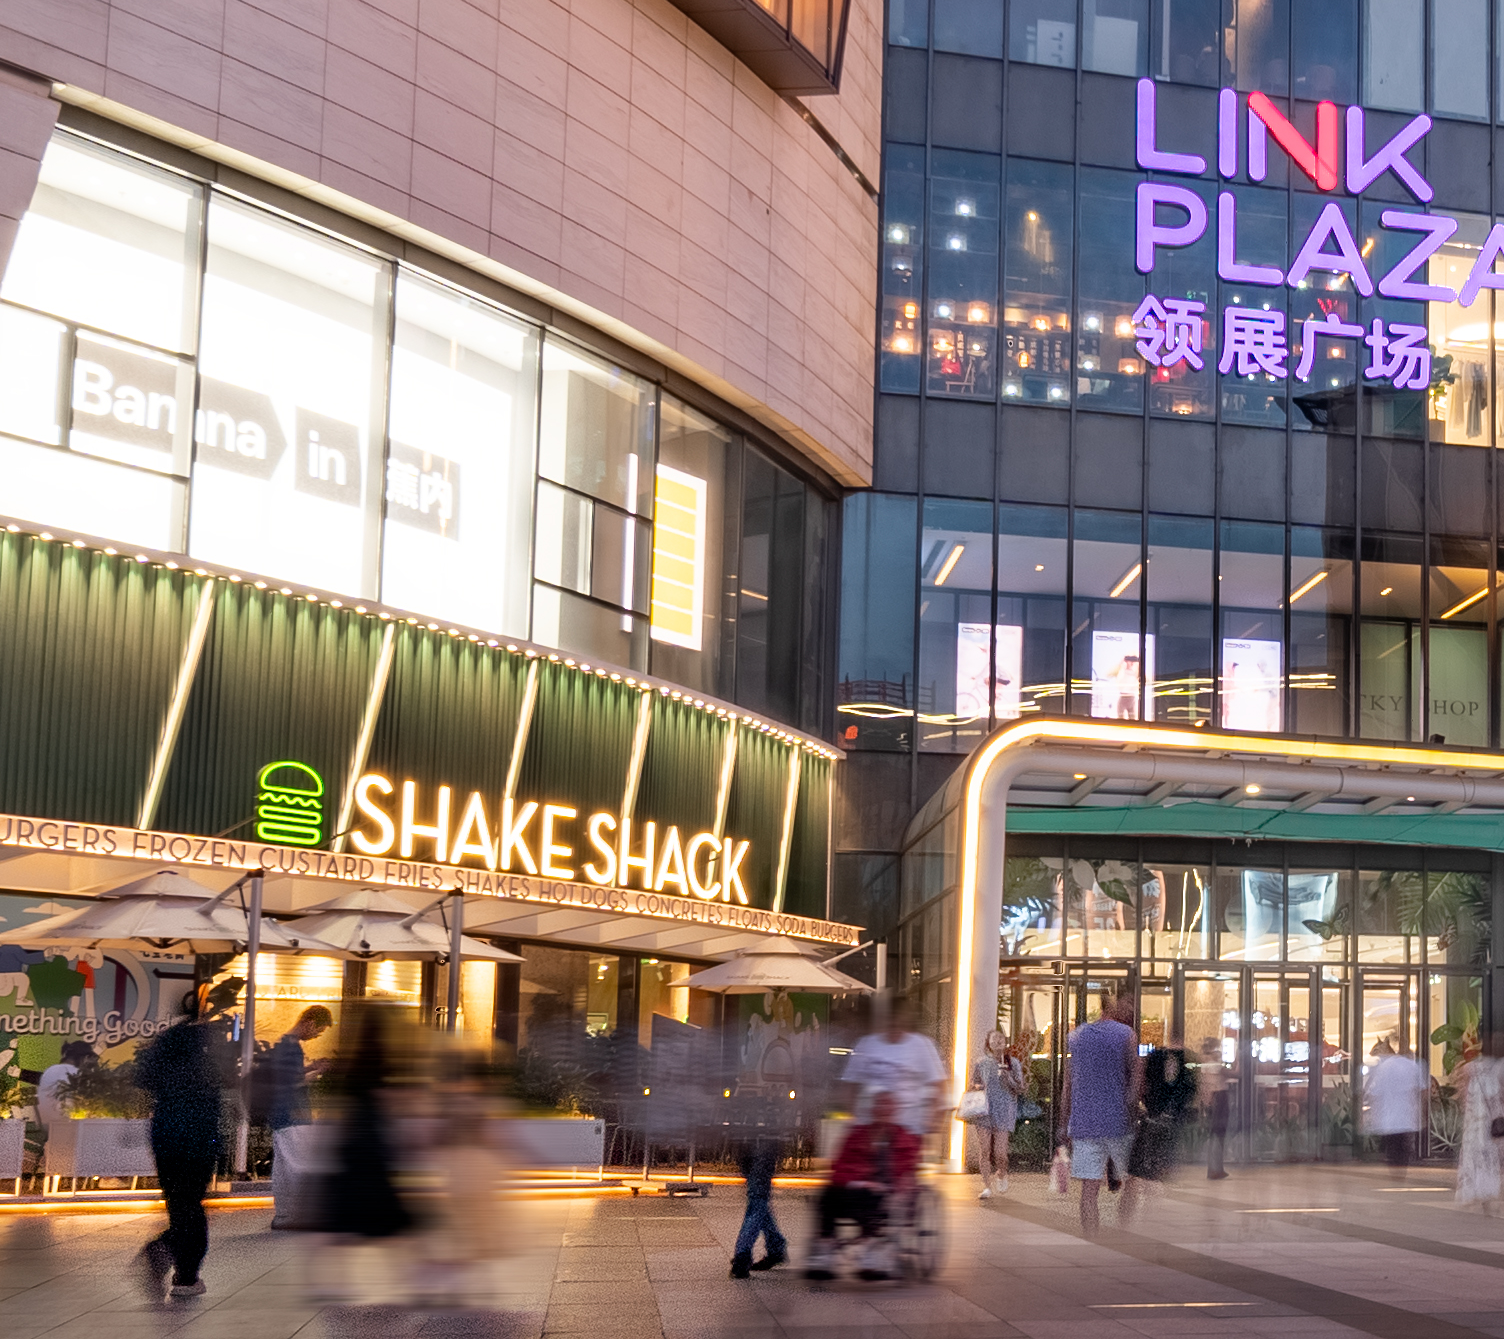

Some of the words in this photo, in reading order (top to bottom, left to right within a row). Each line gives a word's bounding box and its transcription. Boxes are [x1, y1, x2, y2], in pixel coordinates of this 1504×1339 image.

[1135, 76, 1435, 204] LINK
[1131, 293, 1433, 391] 领展广场
[72, 357, 268, 461] Banna
[132, 832, 247, 867] FROZEN
[258, 846, 375, 882] CUSTARD
[384, 860, 444, 890] FRIES
[454, 868, 531, 900] SHAKES
[538, 881, 578, 905] HOT
[580, 886, 629, 912] DOGS
[635, 893, 723, 925] CONCRETES
[727, 906, 773, 932] FLOATS
[776, 914, 807, 937] SODA
[810, 919, 854, 945] BURGERS
[350, 772, 578, 880] SHAKE
[582, 811, 751, 905] SHACK
[101, 1009, 177, 1045] Good
